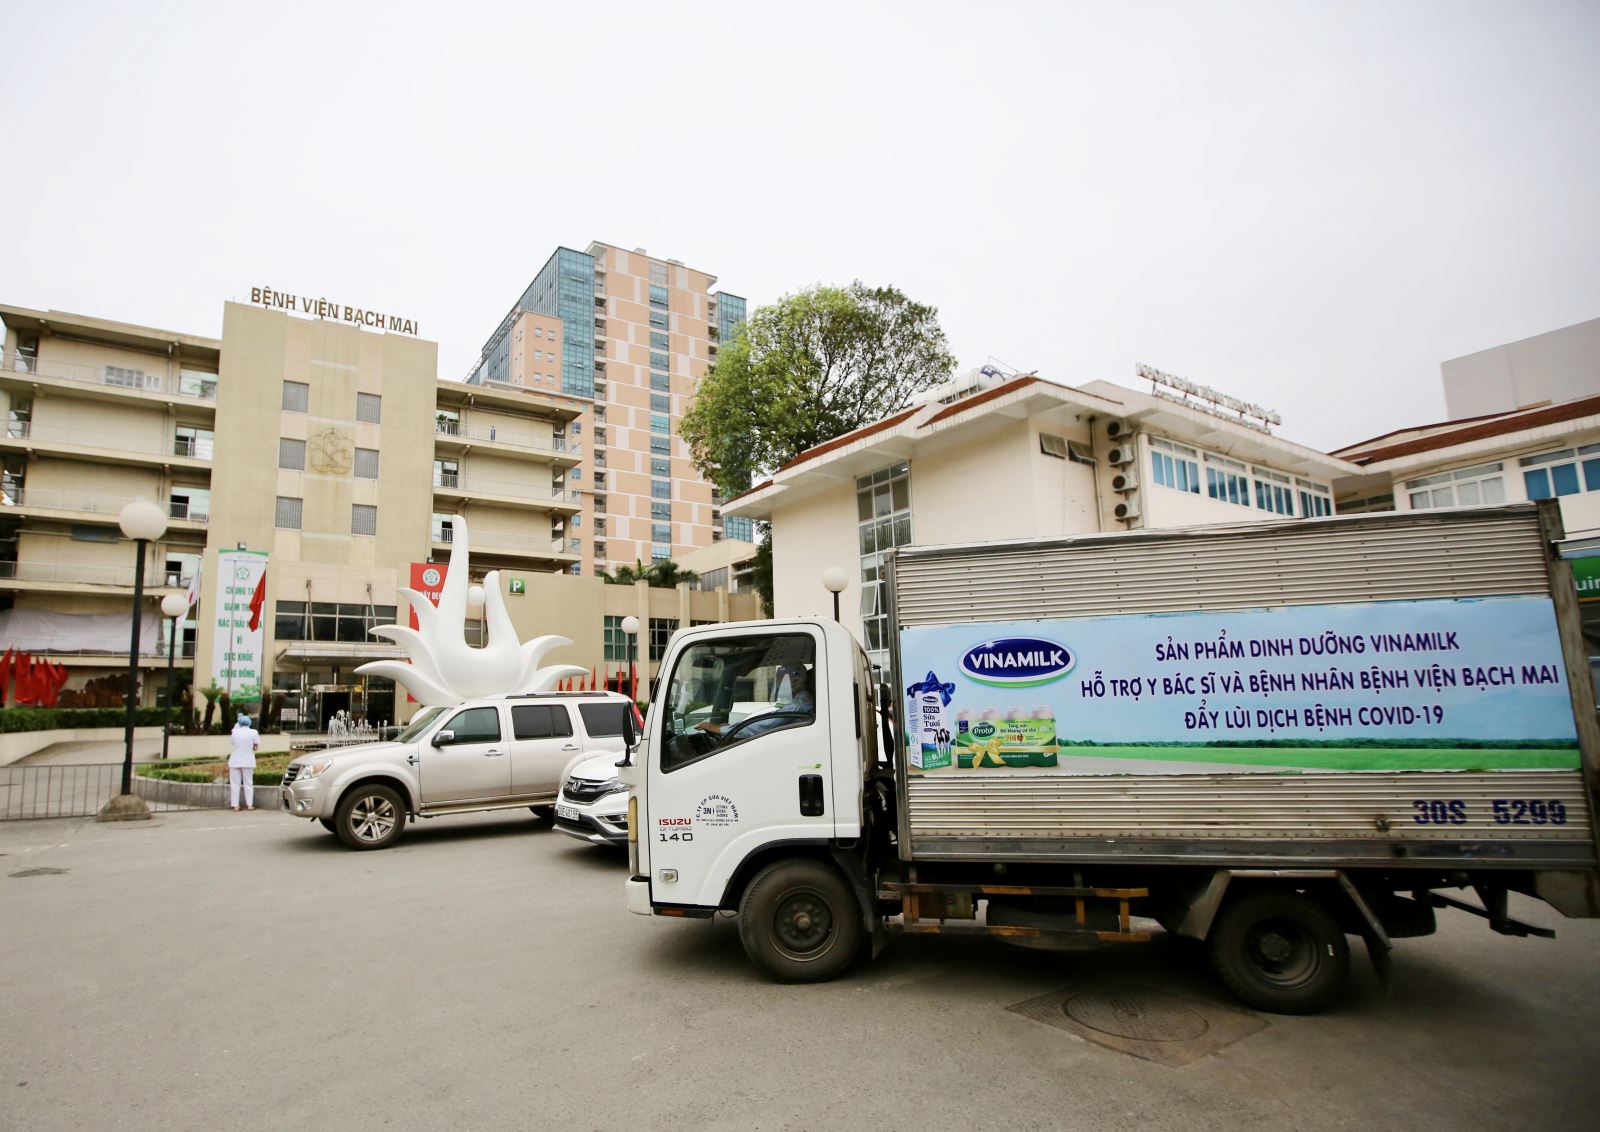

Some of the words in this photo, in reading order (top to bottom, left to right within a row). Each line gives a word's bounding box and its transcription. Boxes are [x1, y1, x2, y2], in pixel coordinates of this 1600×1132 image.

[251, 286, 296, 310] BỆNH
[302, 297, 339, 320] VIỆN
[344, 305, 385, 328] BẠCH
[389, 316, 418, 335] MAI
[512, 581, 521, 592] P
[1155, 636, 1189, 662] SẢN
[1194, 629, 1245, 660] PHẨM
[1250, 638, 1294, 658] DINH
[1299, 630, 1365, 656] DƯỠNG
[1370, 631, 1460, 653] VINAMILK
[969, 650, 1065, 669] VINAMILK
[1081, 670, 1106, 698] HỖ
[1110, 676, 1142, 701] TRỢ
[1147, 678, 1157, 696] Y
[1163, 672, 1196, 696] BÁC
[1200, 671, 1216, 695] SĨ
[1220, 671, 1245, 694] VÀ
[1249, 669, 1296, 697] BỆNH
[1301, 667, 1354, 691] NHÂN
[1360, 665, 1410, 694] BỆNH
[1414, 663, 1457, 693] VIỆN
[1462, 666, 1516, 692] BẠCH
[1522, 664, 1559, 685] MAI
[1184, 699, 1219, 730] ĐẨY
[1225, 705, 1251, 729] LÙI
[1256, 708, 1298, 733] DỊCH
[1304, 703, 1353, 732] BỆNH
[1358, 705, 1444, 727] COVID-19
[659, 818, 692, 826] ISUZU
[1412, 800, 1467, 825] 30S
[1492, 800, 1567, 825] 5299
[659, 832, 693, 842] 140
